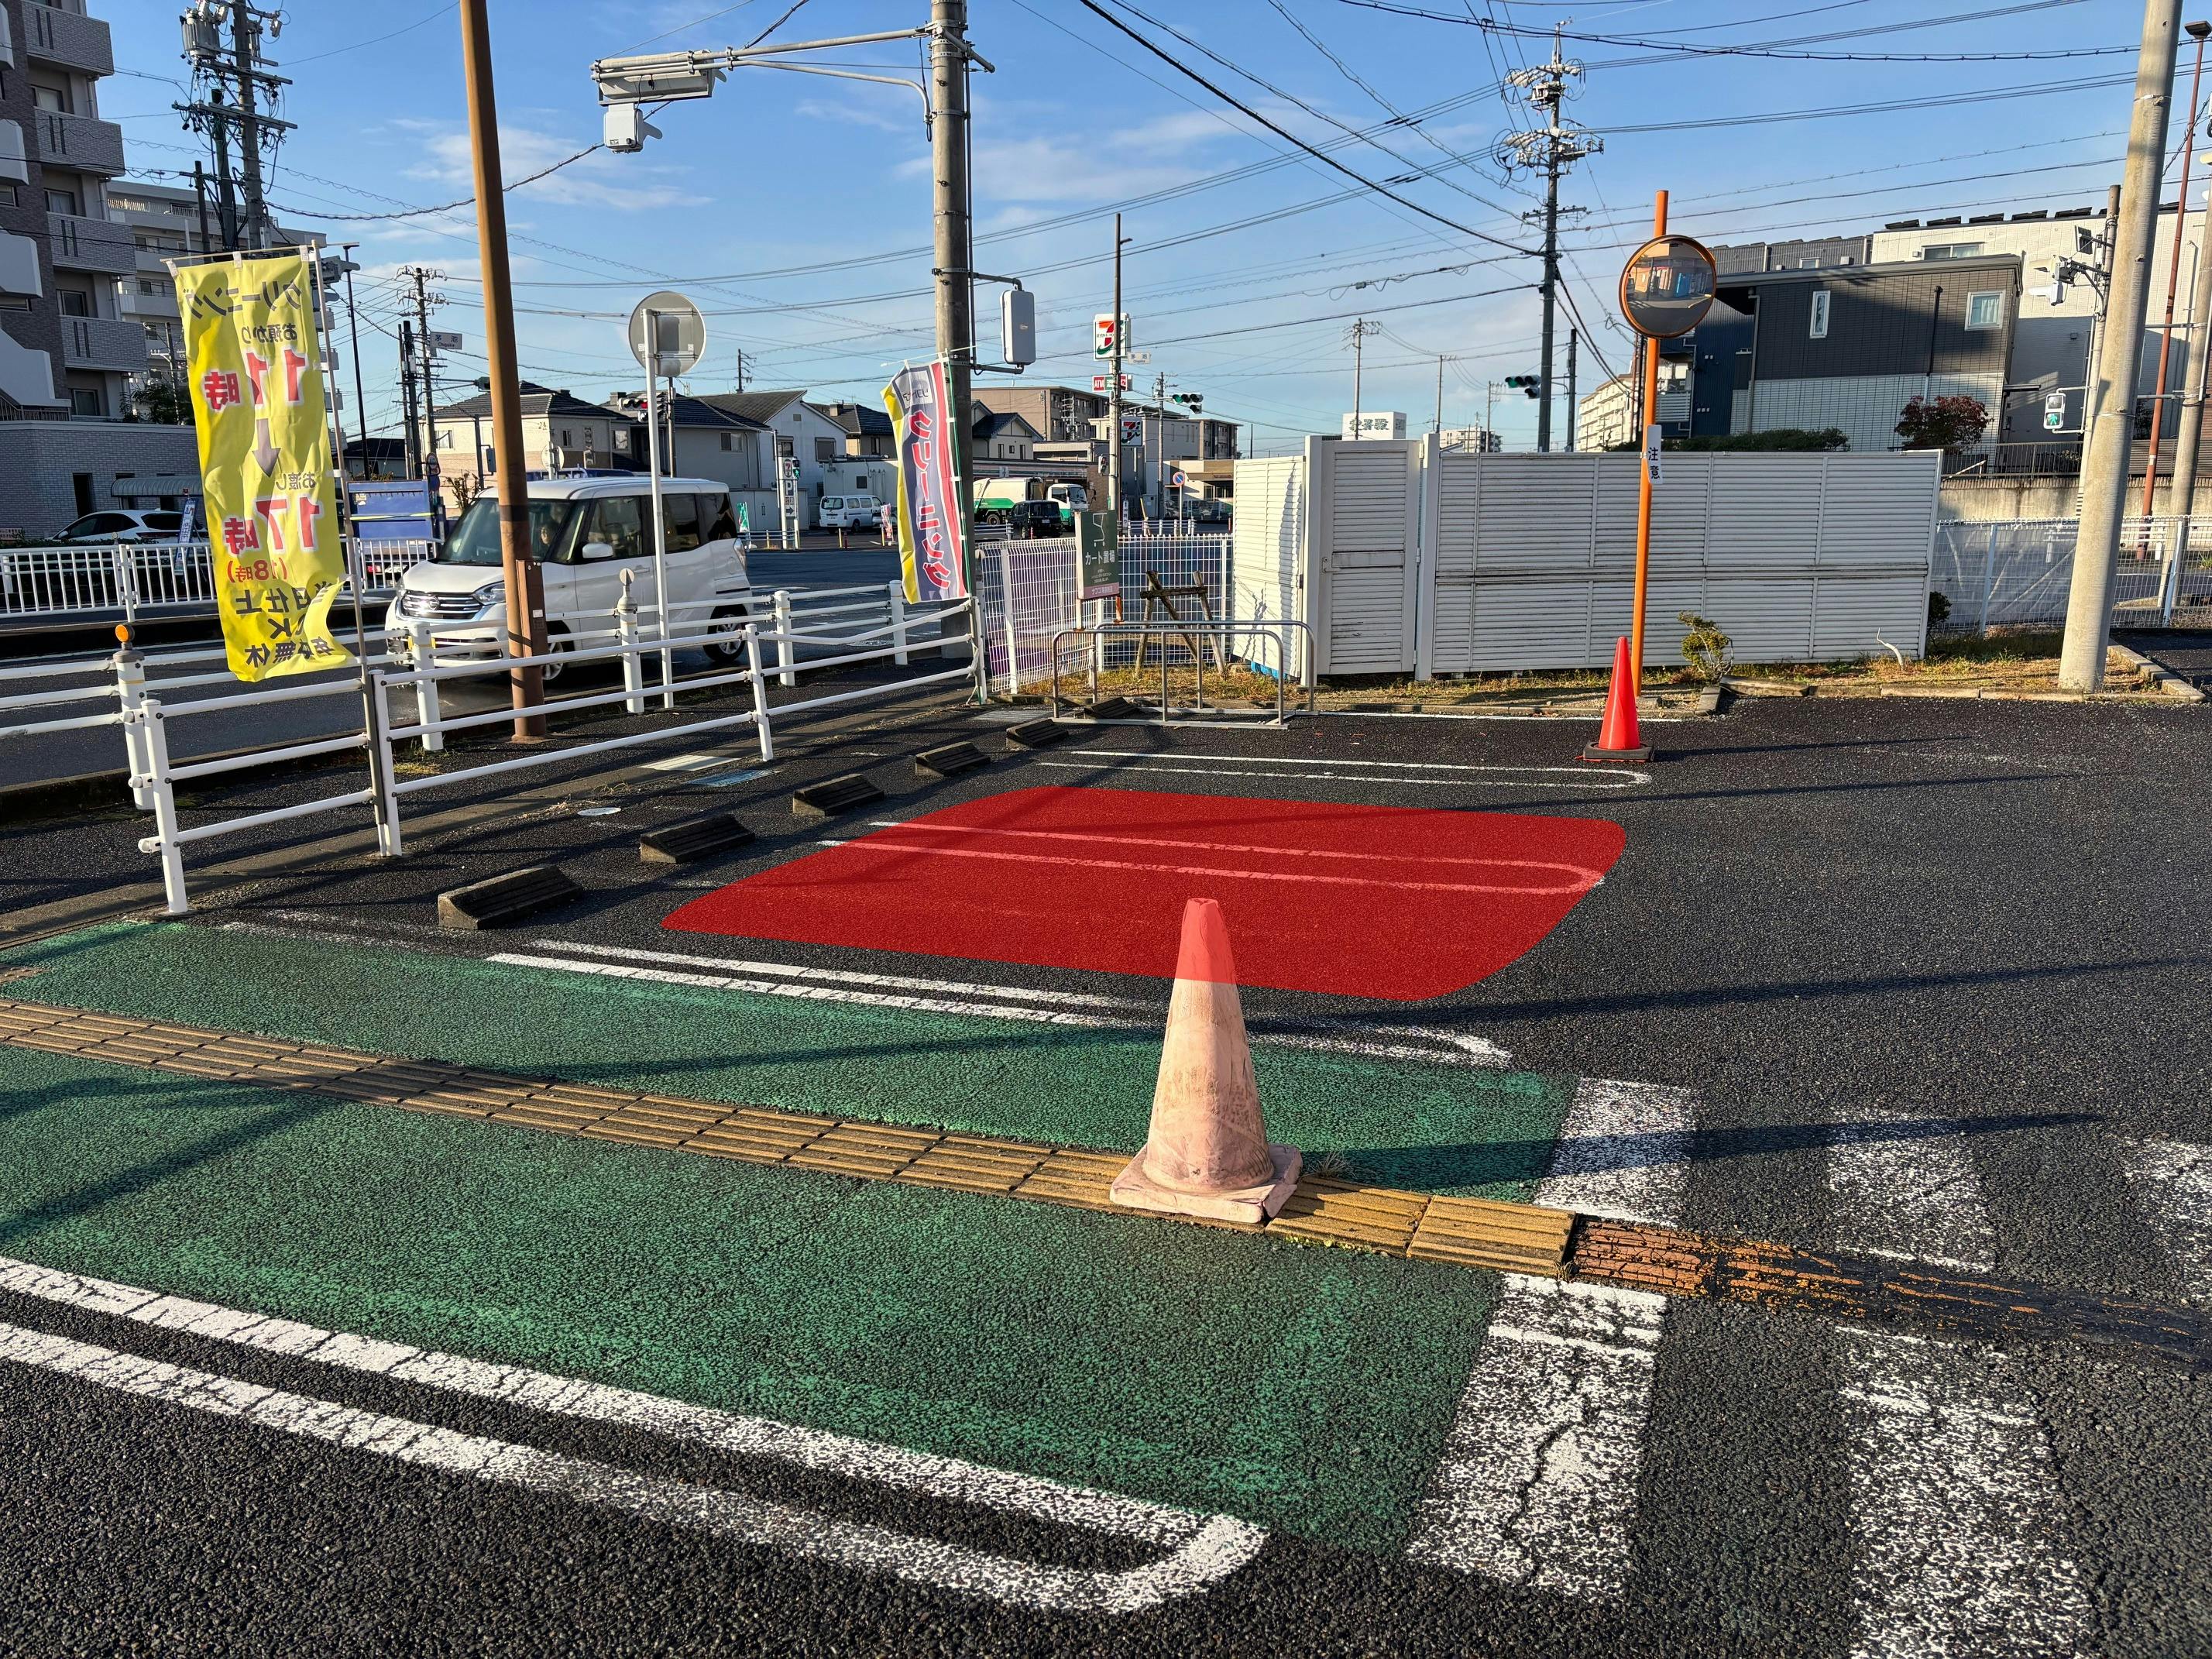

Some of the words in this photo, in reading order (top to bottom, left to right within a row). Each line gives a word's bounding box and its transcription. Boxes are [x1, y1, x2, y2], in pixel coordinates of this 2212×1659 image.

[1094, 380, 1104, 388] ATM
[1648, 447, 1660, 479] 注意
[785, 480, 793, 496] P
[1085, 550, 1115, 565] カート置場
